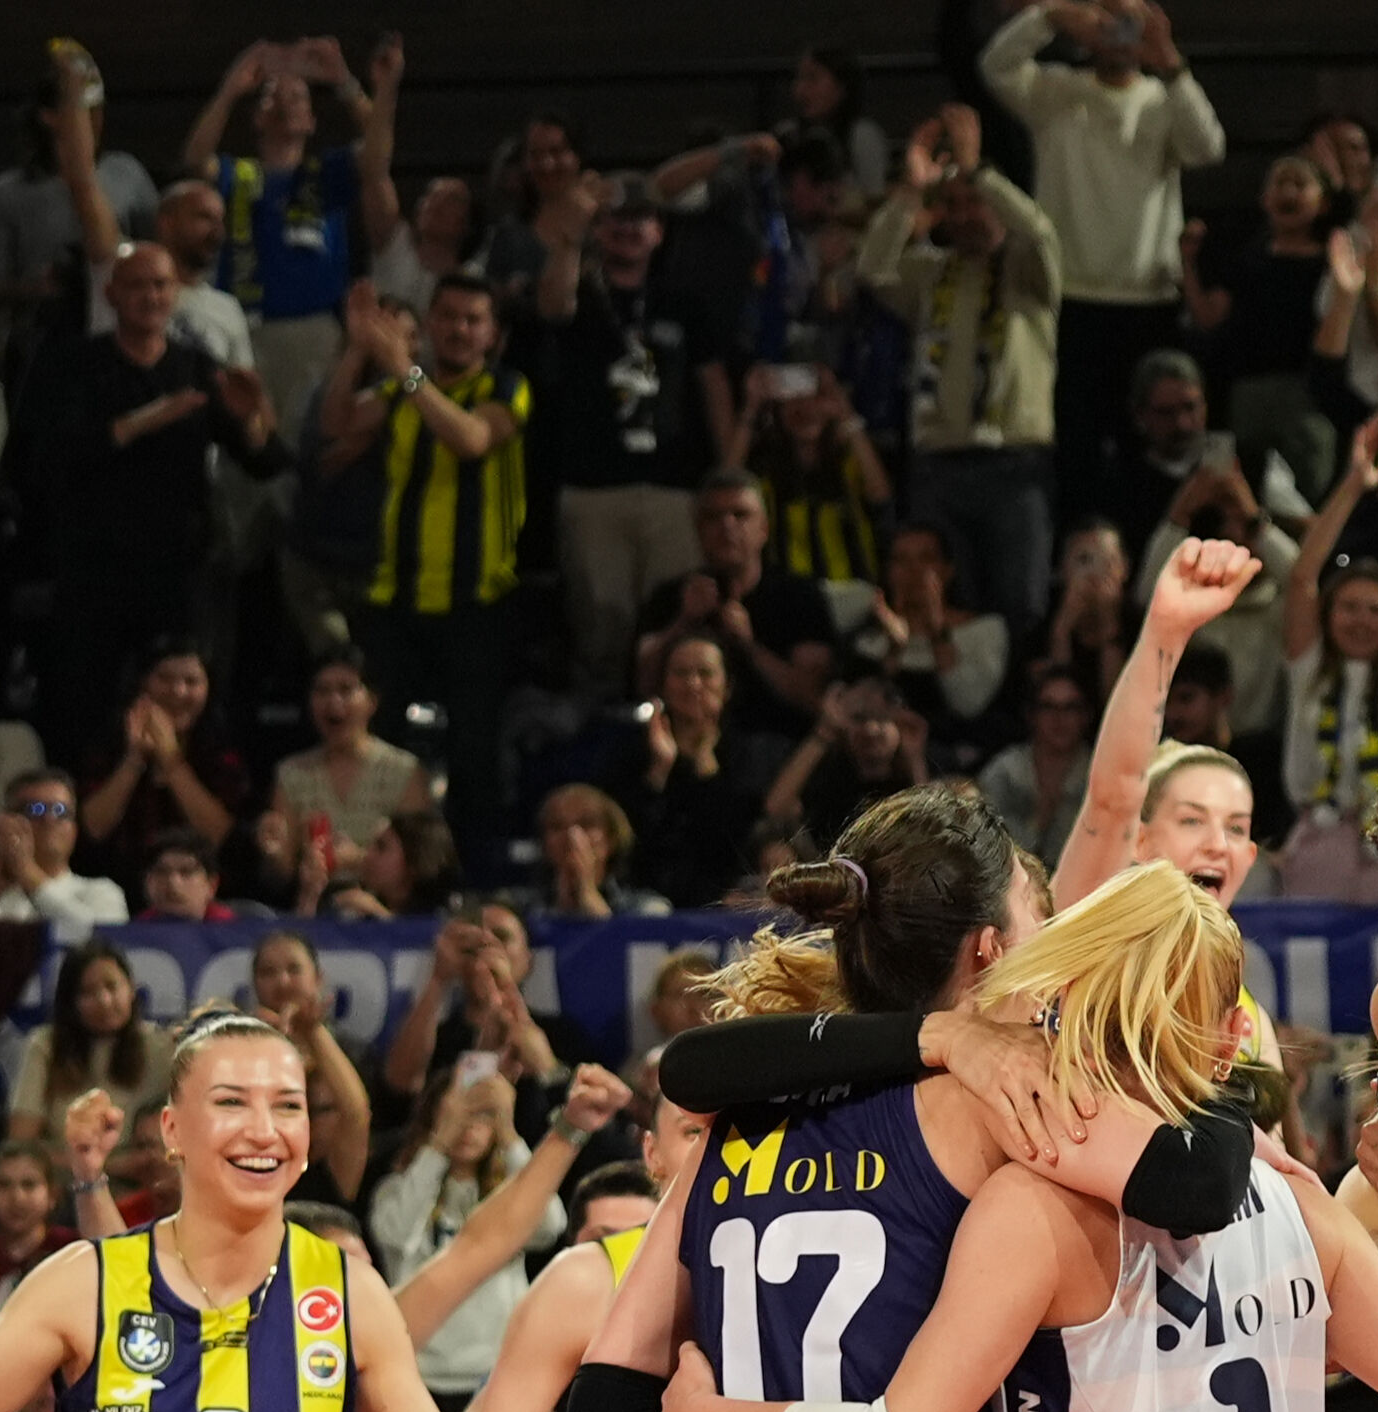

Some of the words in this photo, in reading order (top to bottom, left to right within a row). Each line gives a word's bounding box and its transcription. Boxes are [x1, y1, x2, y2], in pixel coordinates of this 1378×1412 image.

[132, 1314, 157, 1328] CEV
[710, 1209, 886, 1402] 17
[1156, 1253, 1315, 1351] MOD
